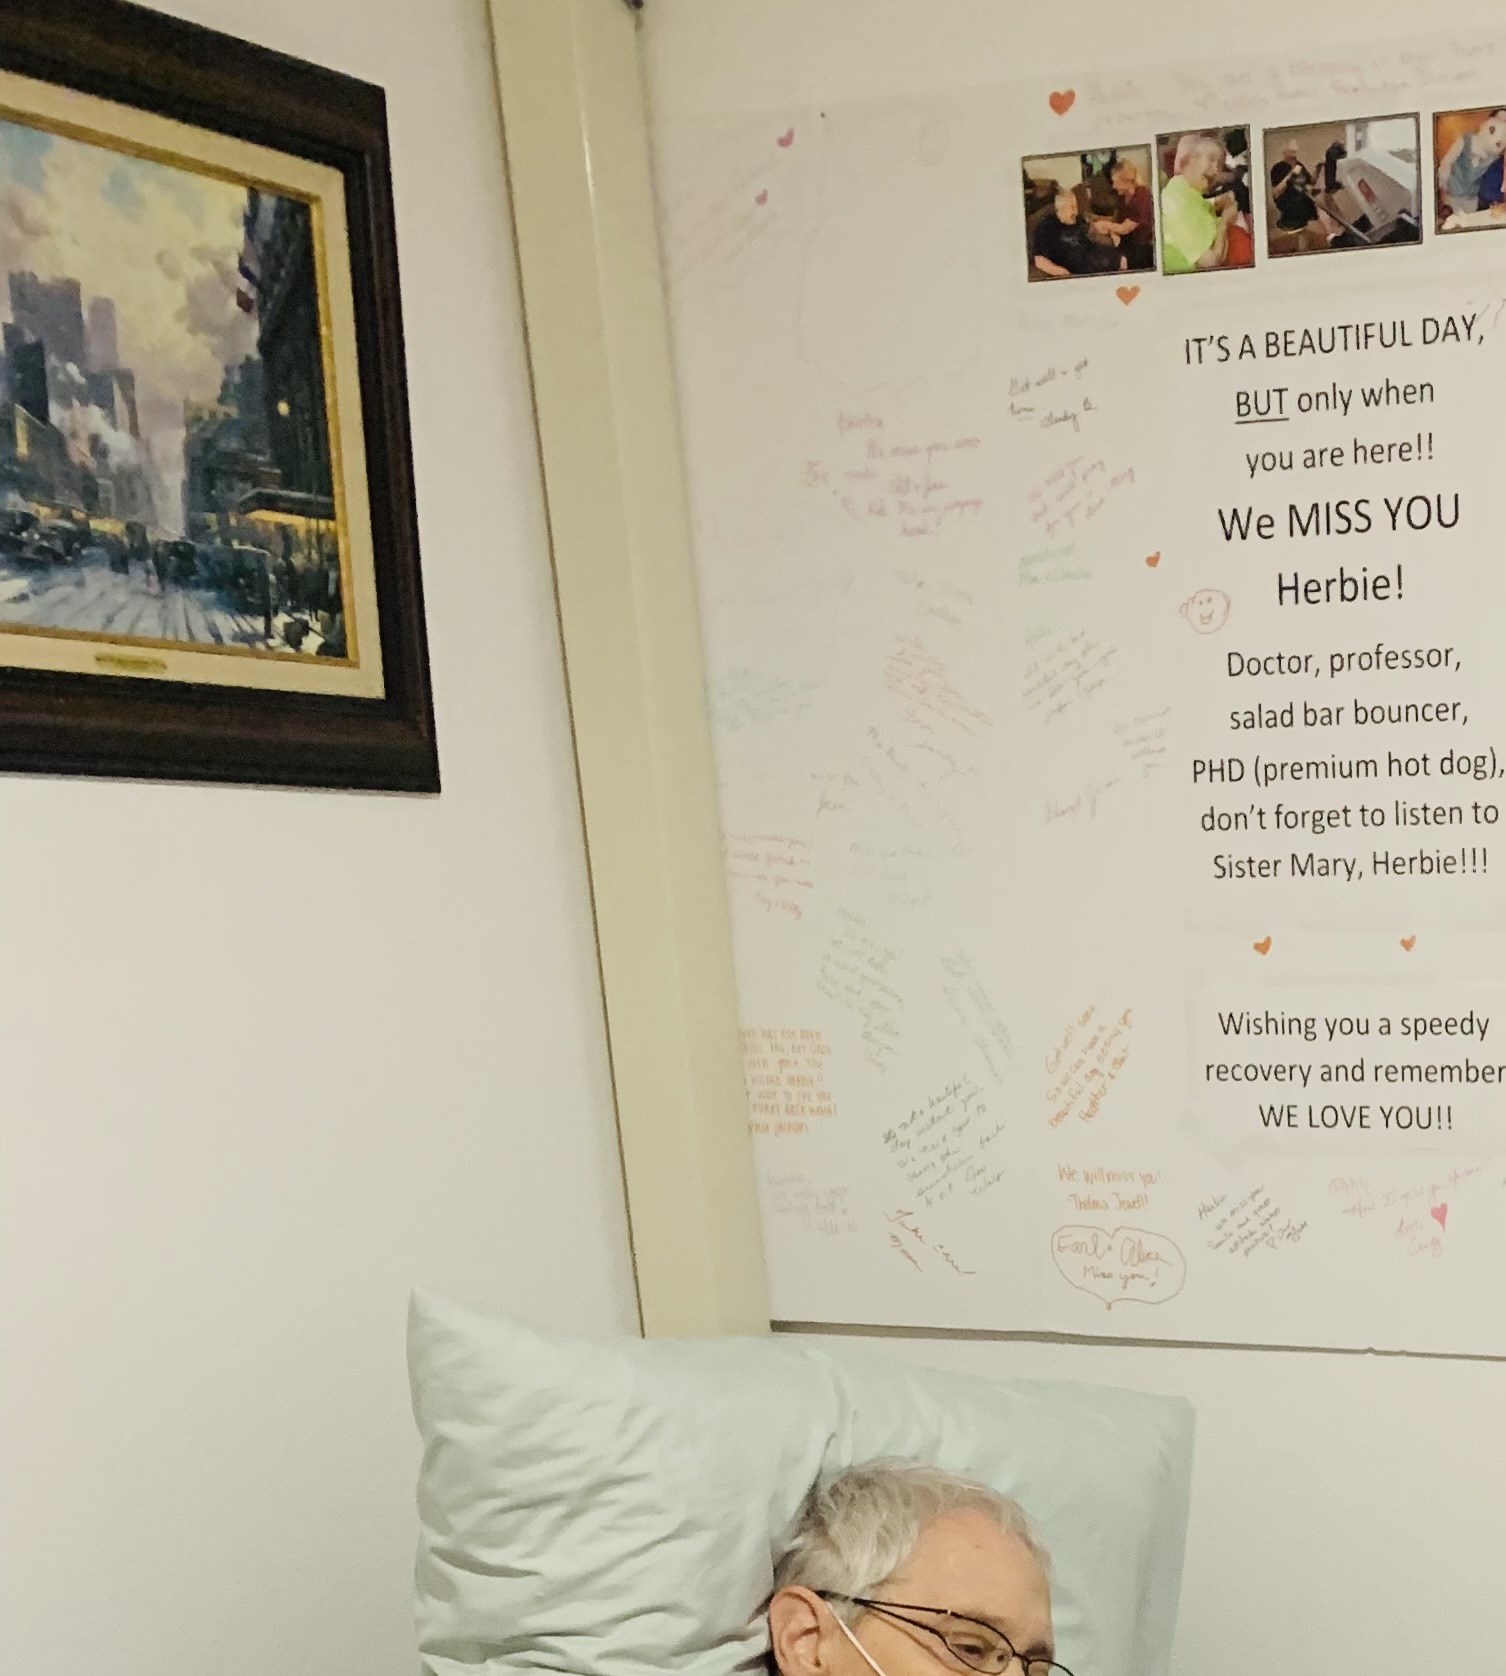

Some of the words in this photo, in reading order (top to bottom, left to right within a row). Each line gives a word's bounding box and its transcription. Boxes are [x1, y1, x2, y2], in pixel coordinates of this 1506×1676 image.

[1238, 334, 1256, 360] A
[1264, 320, 1413, 359] BEAUTIFUL
[1422, 313, 1485, 346] DAY,
[1235, 387, 1289, 422] BUT
[1297, 382, 1352, 416] only
[1361, 377, 1435, 408] when
[1246, 449, 1294, 478] you
[1303, 446, 1344, 469] are
[1353, 432, 1434, 465] here!!
[1217, 505, 1275, 542] We
[1288, 498, 1372, 538] MISS
[1383, 492, 1460, 531] YOU
[1277, 563, 1404, 606] Herbie!
[1227, 651, 1321, 678] Doctor,
[1329, 643, 1462, 678] professor,
[1229, 701, 1294, 730] salad
[1303, 701, 1344, 727] bar
[1353, 698, 1469, 726] bouncer,
[1192, 758, 1245, 784] PHD
[1254, 754, 1378, 787] (premium
[1387, 751, 1431, 778] hot
[1439, 746, 1506, 781] dog),
[1274, 803, 1352, 835] forget
[1359, 804, 1386, 828] to
[1394, 800, 1463, 827] listen
[1471, 801, 1500, 825] to
[1213, 853, 1282, 880] Sister
[1290, 852, 1364, 882] Mary,
[1372, 847, 1488, 876] Herbie!!!
[1218, 1010, 1317, 1042] Wishing
[1324, 1017, 1370, 1042] you
[1378, 1017, 1391, 1036] a
[1400, 1010, 1490, 1042] speedy
[1205, 1063, 1312, 1088] recovery
[1320, 1057, 1365, 1083] and
[1374, 1057, 1506, 1084] remember
[1258, 1104, 1299, 1129] WE
[1308, 1104, 1371, 1129] LOVE
[1379, 1104, 1453, 1131] YOU!!
